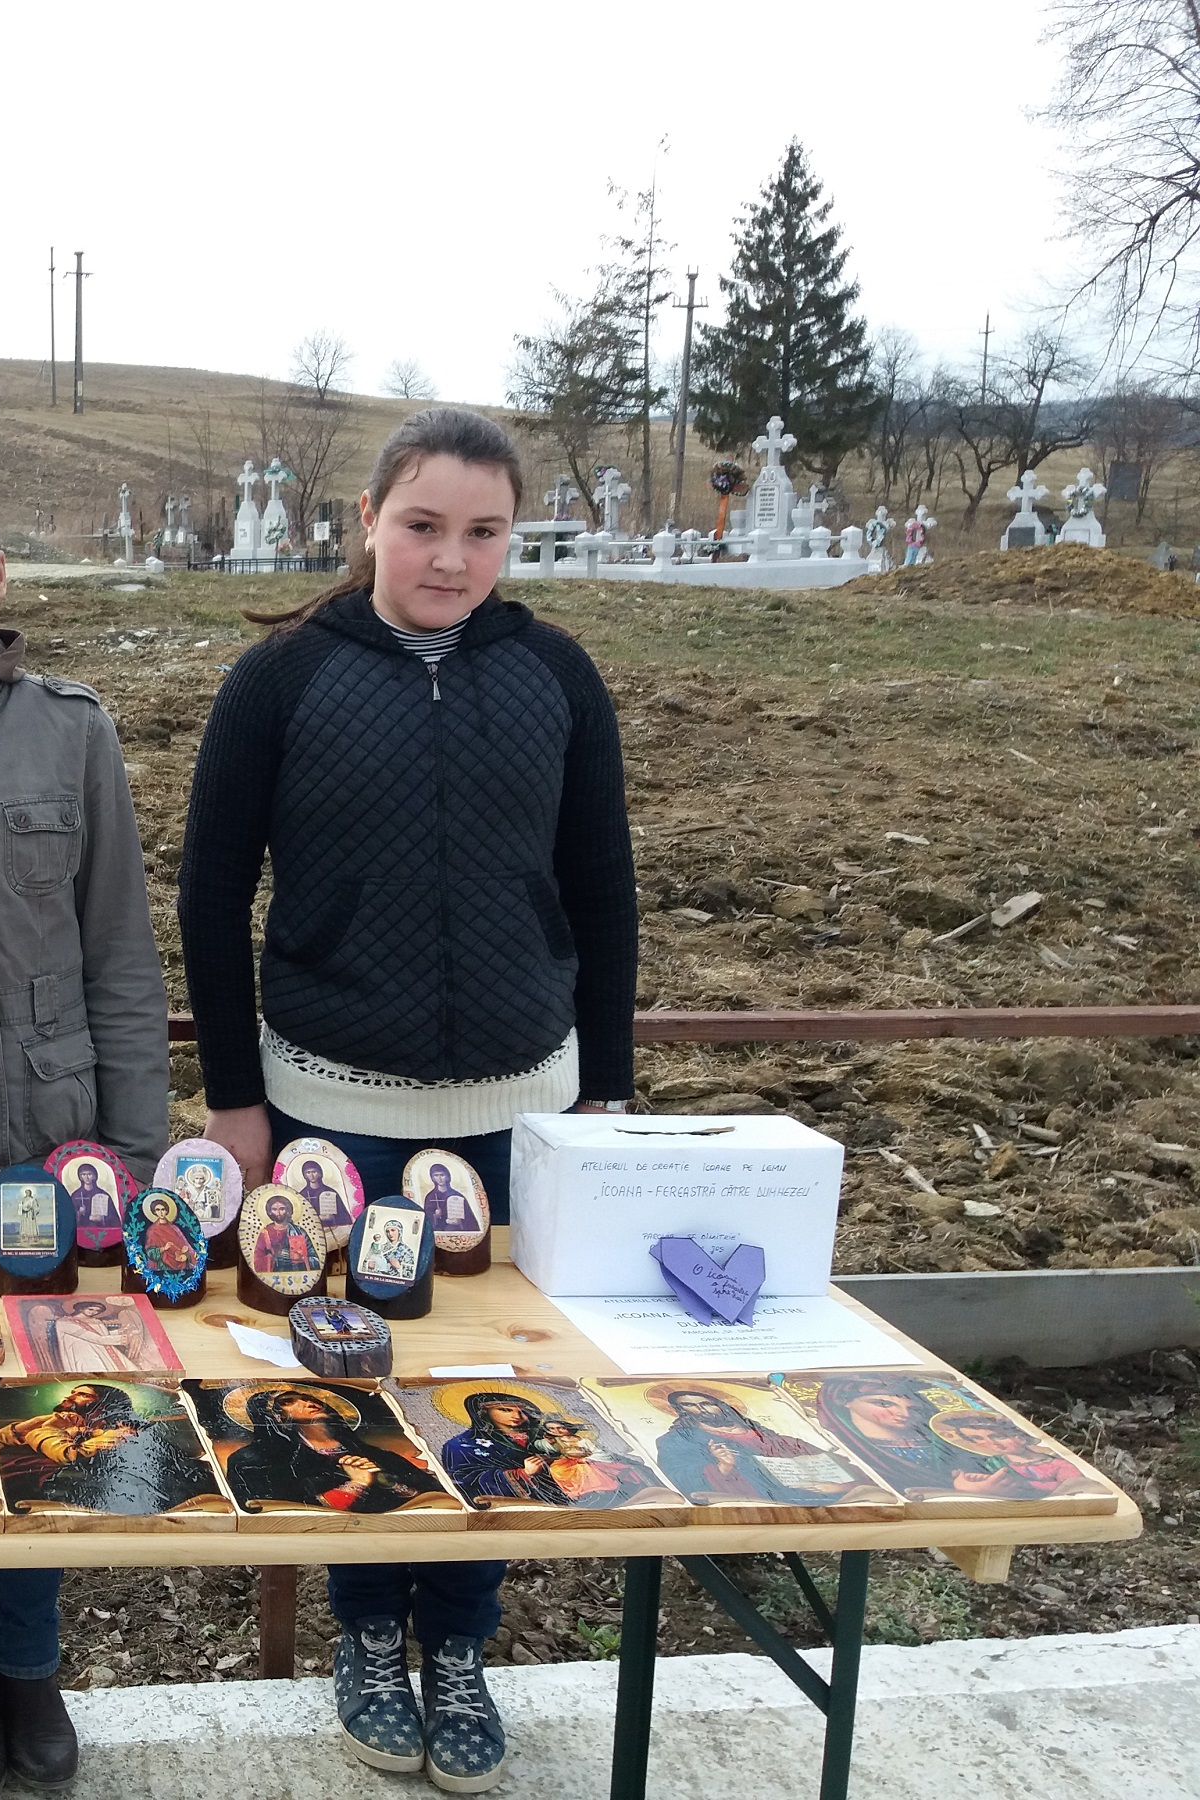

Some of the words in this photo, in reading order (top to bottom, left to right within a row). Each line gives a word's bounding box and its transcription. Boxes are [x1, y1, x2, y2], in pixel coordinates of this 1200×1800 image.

[581, 1160, 628, 1171] ATELIERUL
[636, 1162, 648, 1171] DE
[702, 1162, 732, 1172] ICOANE
[742, 1163, 754, 1172] PE
[761, 1163, 788, 1172] LEMN
